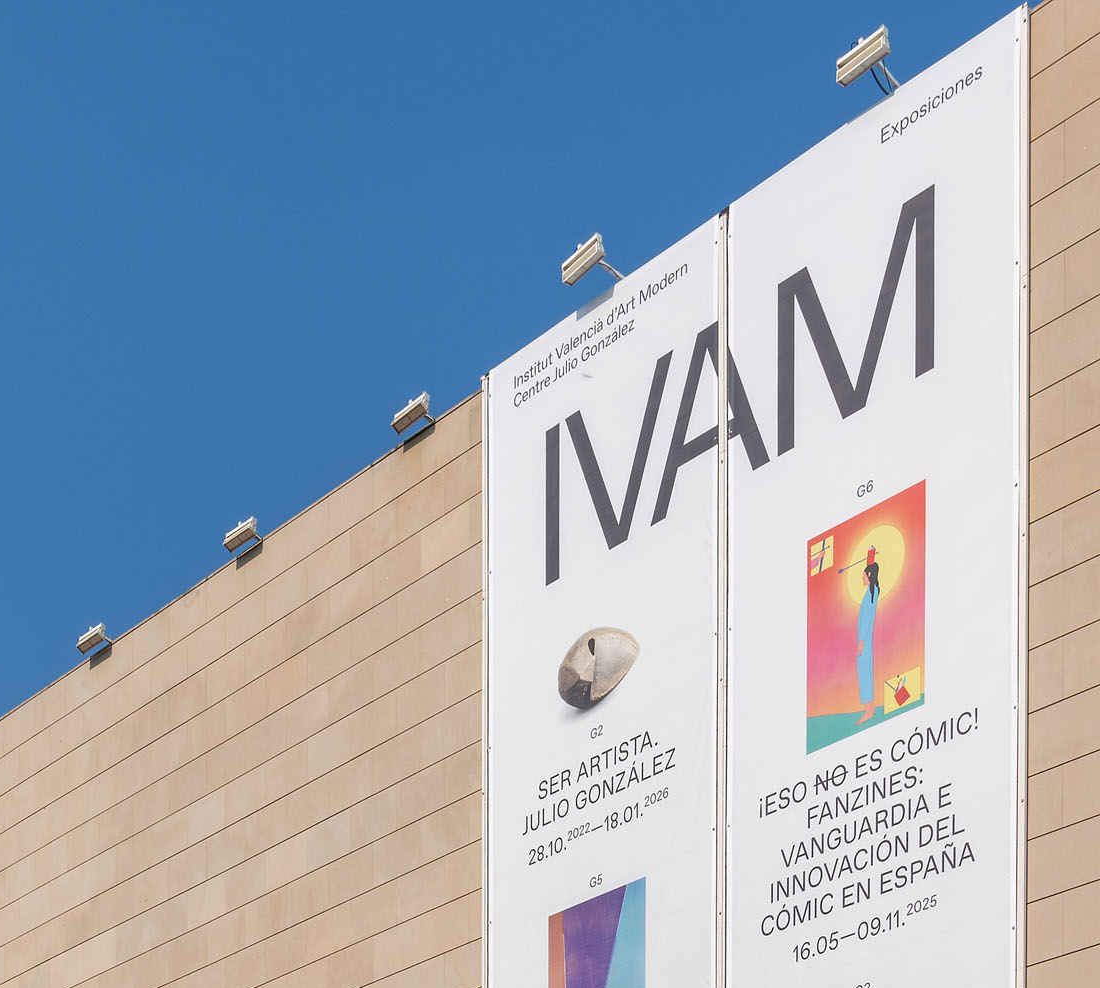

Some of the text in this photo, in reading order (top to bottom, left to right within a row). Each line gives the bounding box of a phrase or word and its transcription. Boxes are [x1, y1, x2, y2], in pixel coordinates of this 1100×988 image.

[880, 63, 983, 144] Exposiciones
[513, 352, 553, 389] Institut
[555, 318, 603, 360] Valencià
[639, 263, 688, 305] Modern
[513, 318, 635, 407] Centre Julio González
[545, 184, 935, 586] IVAM
[857, 480, 874, 498] G6
[538, 730, 658, 800] SER ARTISTA.
[590, 724, 603, 739] G2
[813, 764, 849, 795] NO
[855, 749, 882, 778] ES
[890, 707, 978, 762] CÓMIC!
[522, 747, 676, 836] JULIO GONZÁLEZ
[780, 783, 952, 868] VANGUARDIA E
[807, 765, 924, 829] FANZINES:
[589, 874, 603, 888] G5
[760, 842, 975, 937] CÓMIC EN ESPAÑA
[770, 814, 965, 904] INNOVACIÓN DEL
